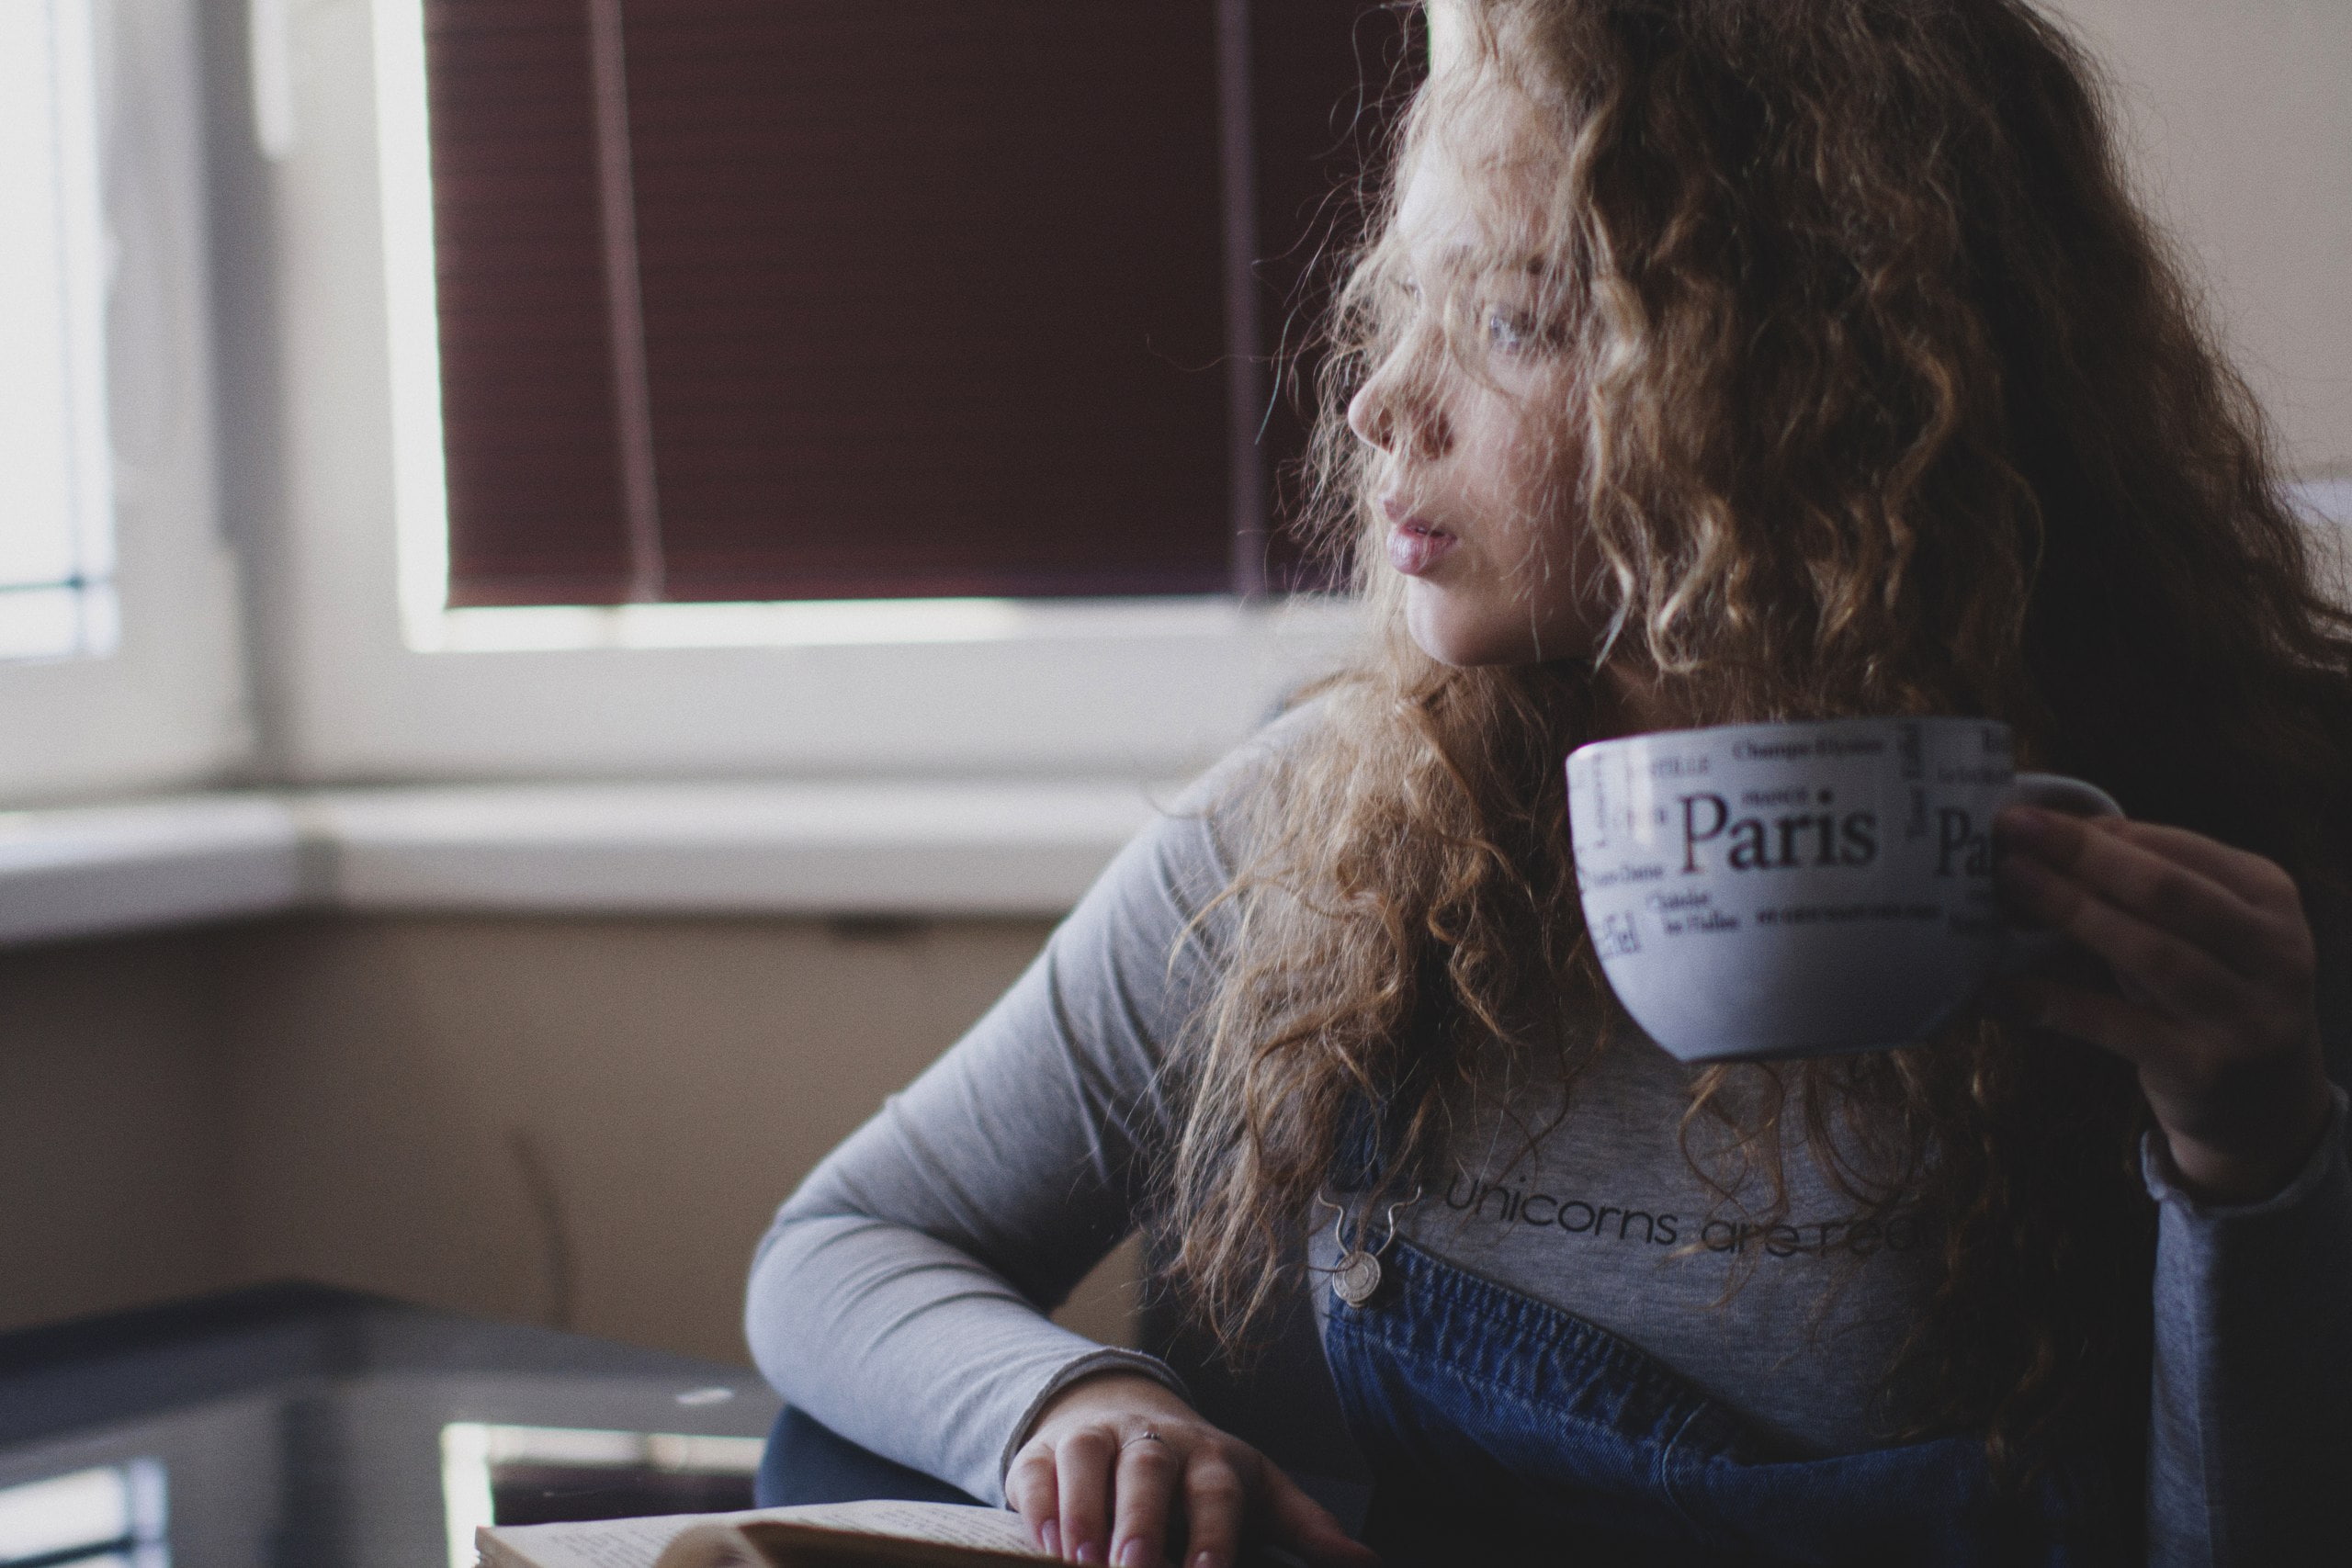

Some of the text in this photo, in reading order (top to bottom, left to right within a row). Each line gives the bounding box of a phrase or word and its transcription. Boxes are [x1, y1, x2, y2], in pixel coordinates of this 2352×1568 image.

[1679, 790, 1879, 874] Paris
[1934, 806, 1994, 878] Pa
[1444, 1174, 1922, 1258] unicorns are rea
